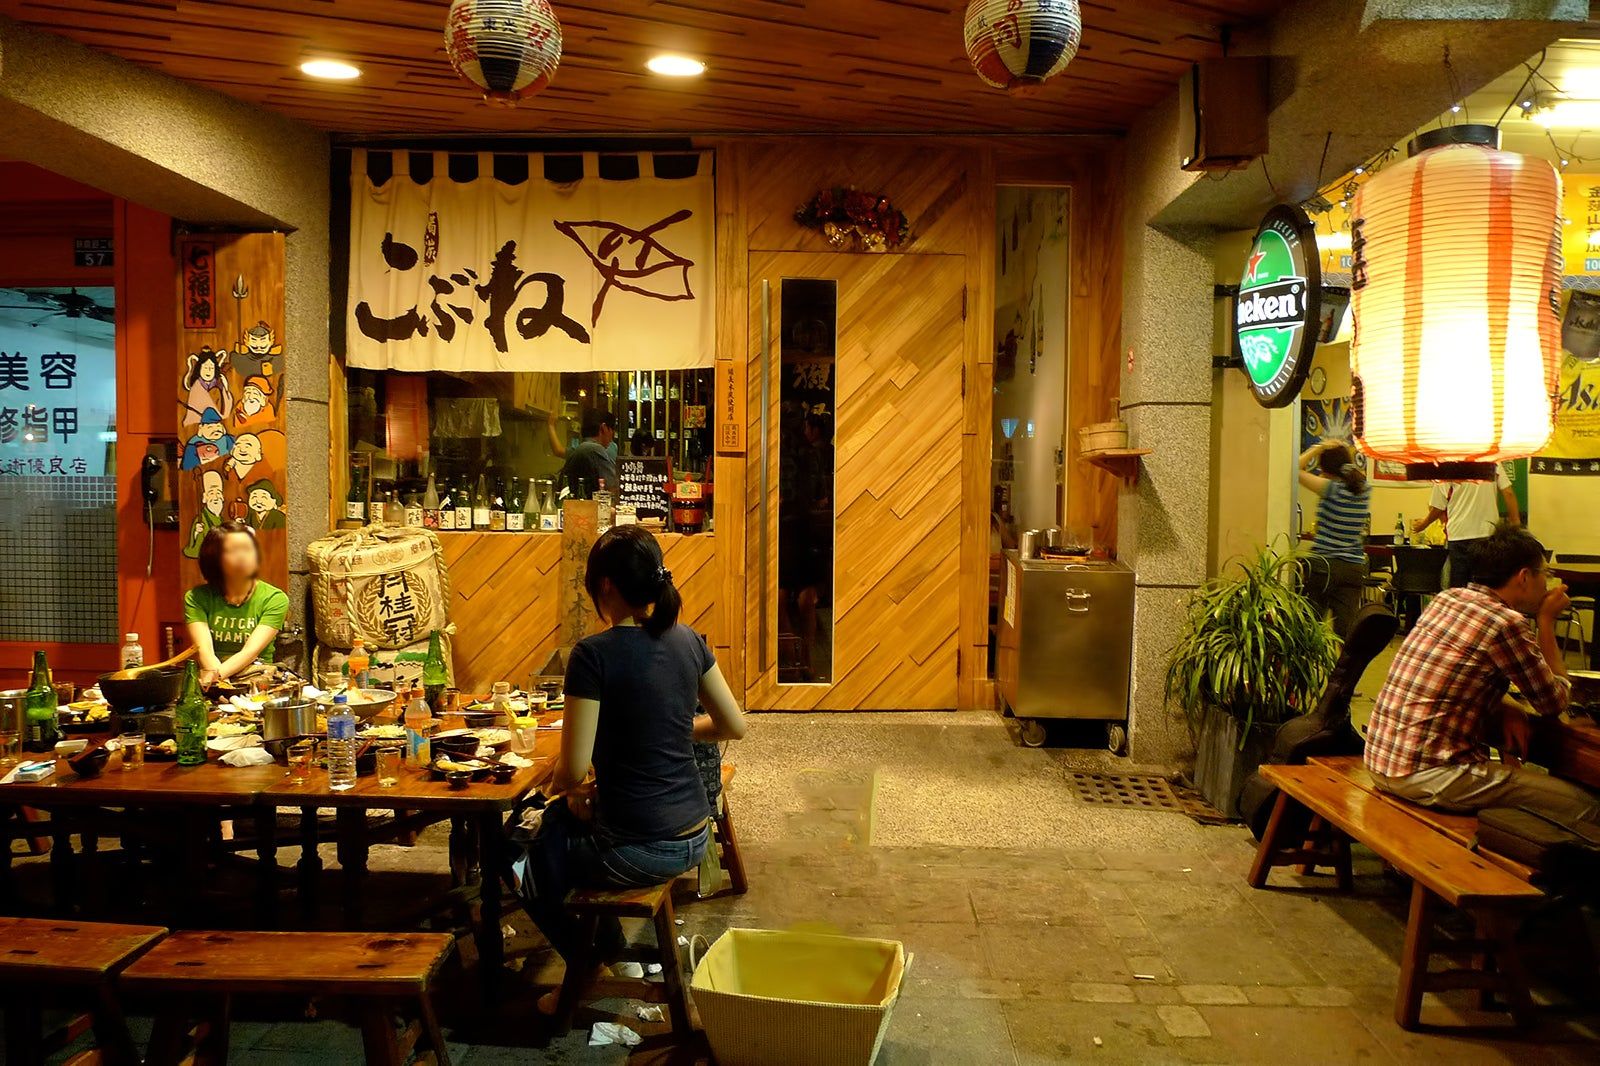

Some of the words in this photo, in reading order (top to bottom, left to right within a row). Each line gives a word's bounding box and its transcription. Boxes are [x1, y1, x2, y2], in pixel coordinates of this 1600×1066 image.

[84, 253, 104, 266] 57
[0, 351, 76, 391] 美容
[0, 406, 78, 444] 修指甲
[377, 571, 416, 645] 月桂冠
[214, 615, 255, 630] FITCH
[209, 629, 251, 644] HAMP
